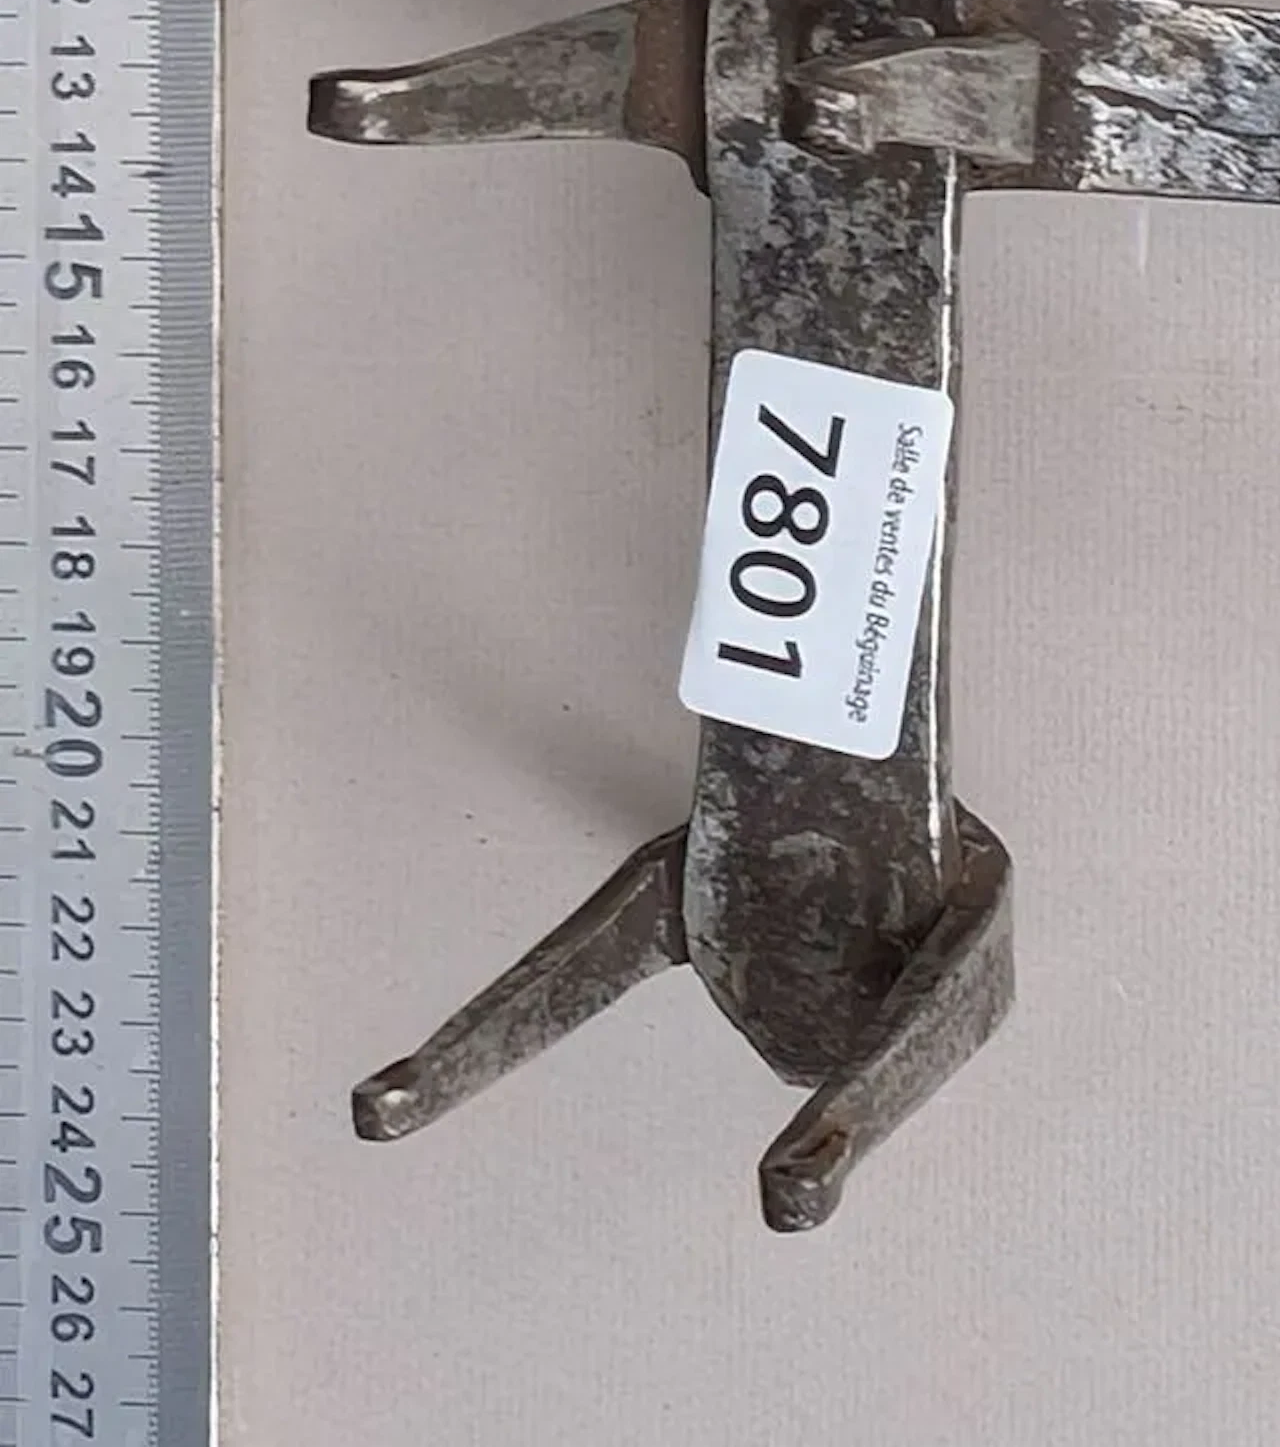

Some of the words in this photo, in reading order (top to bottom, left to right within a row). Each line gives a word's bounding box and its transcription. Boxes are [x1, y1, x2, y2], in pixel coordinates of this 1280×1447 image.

[49, 35, 96, 101] 13
[49, 132, 96, 199] 14
[43, 213, 105, 300] 15
[48, 324, 96, 389] 16
[50, 420, 96, 485] 17
[891, 422, 923, 473] Salle
[886, 477, 914, 504] de
[50, 516, 96, 580] 18
[716, 403, 846, 679] 7801
[873, 509, 901, 576] ventes
[868, 580, 895, 608] du
[50, 611, 96, 676] 19
[45, 688, 103, 777] 20
[50, 799, 96, 860] 21
[51, 894, 95, 961] 22
[51, 990, 95, 1056] 23
[50, 1084, 96, 1153] 24
[43, 1163, 102, 1255] 25
[50, 1274, 95, 1343] 26
[50, 1369, 95, 1438] 27
